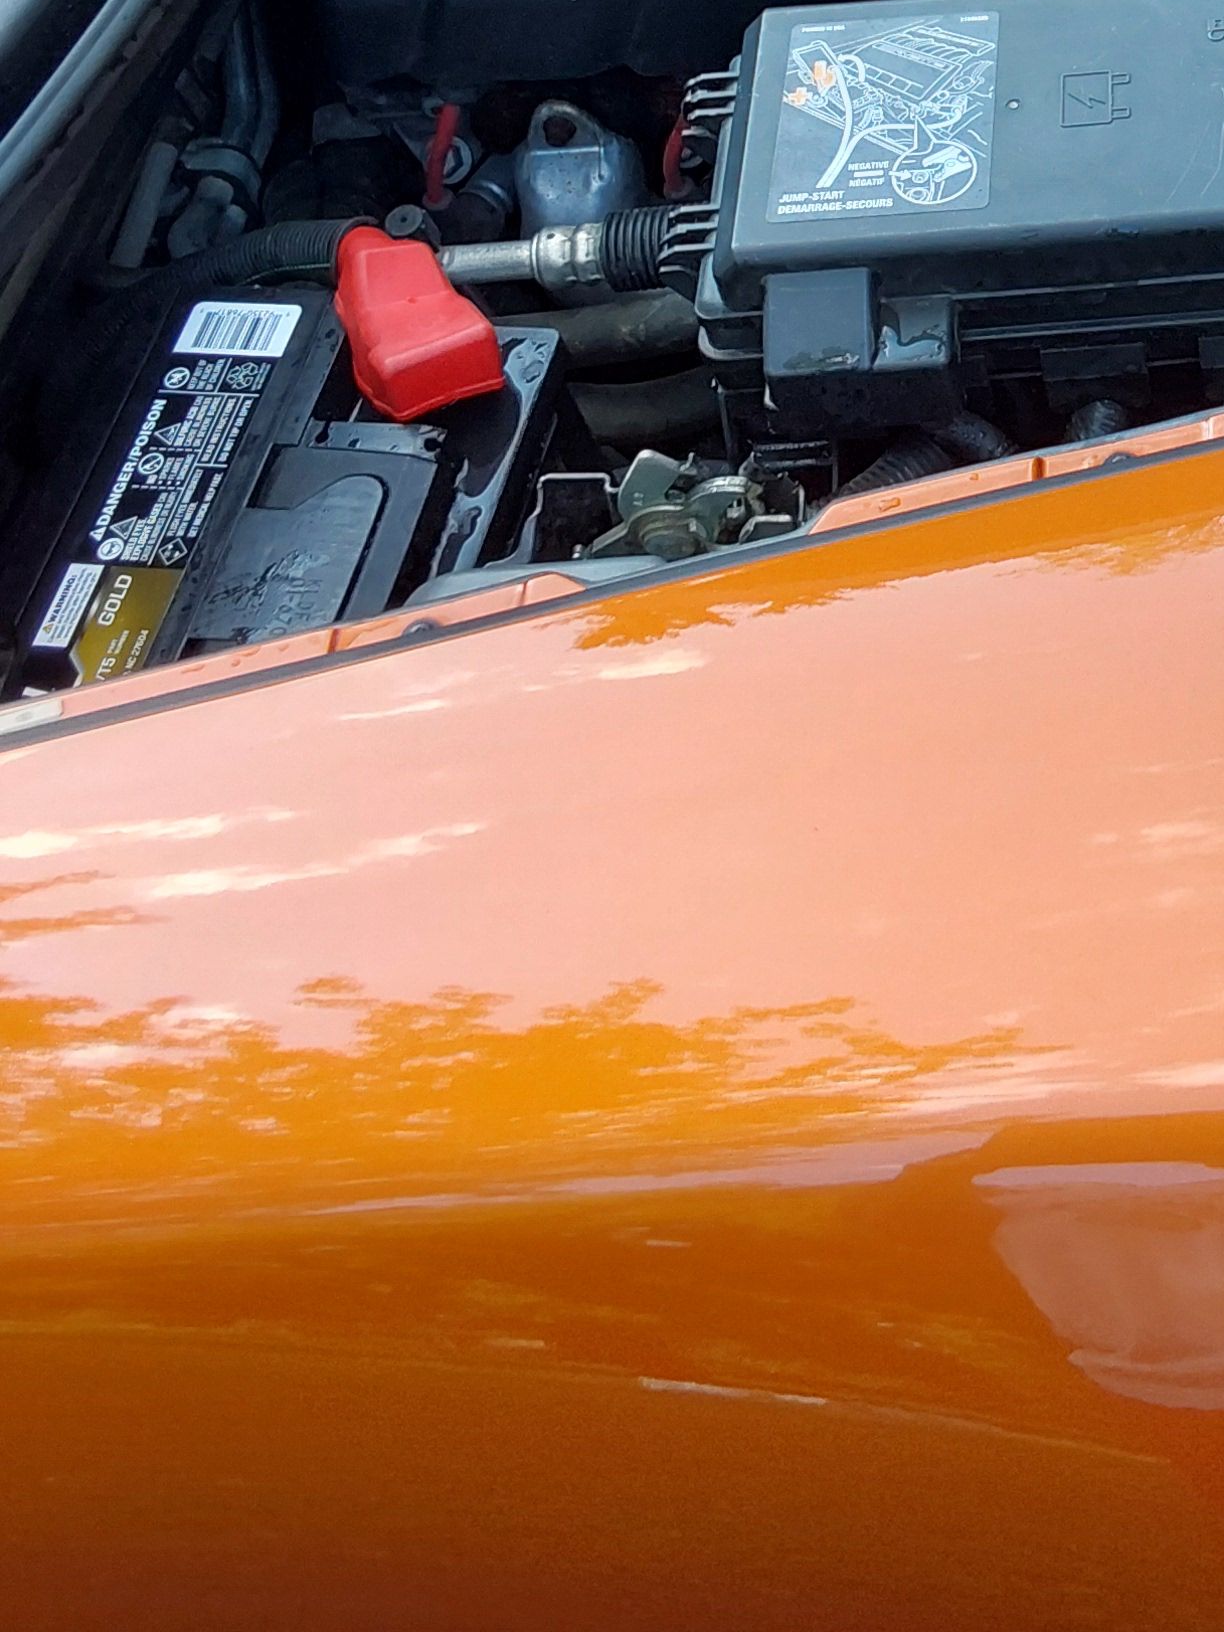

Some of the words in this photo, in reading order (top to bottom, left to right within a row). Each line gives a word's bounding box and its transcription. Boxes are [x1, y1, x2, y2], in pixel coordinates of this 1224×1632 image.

[848, 160, 890, 171] NEGATIVE
[777, 198, 894, 215] DEMARRAGE-SECOURS
[778, 190, 846, 203] JUMP-START
[97, 399, 167, 525] DANGER/POISON
[48, 574, 78, 623] WARNING:
[97, 574, 133, 627] GOLD
[124, 656, 136, 672] NC
[131, 629, 150, 657] 27604
